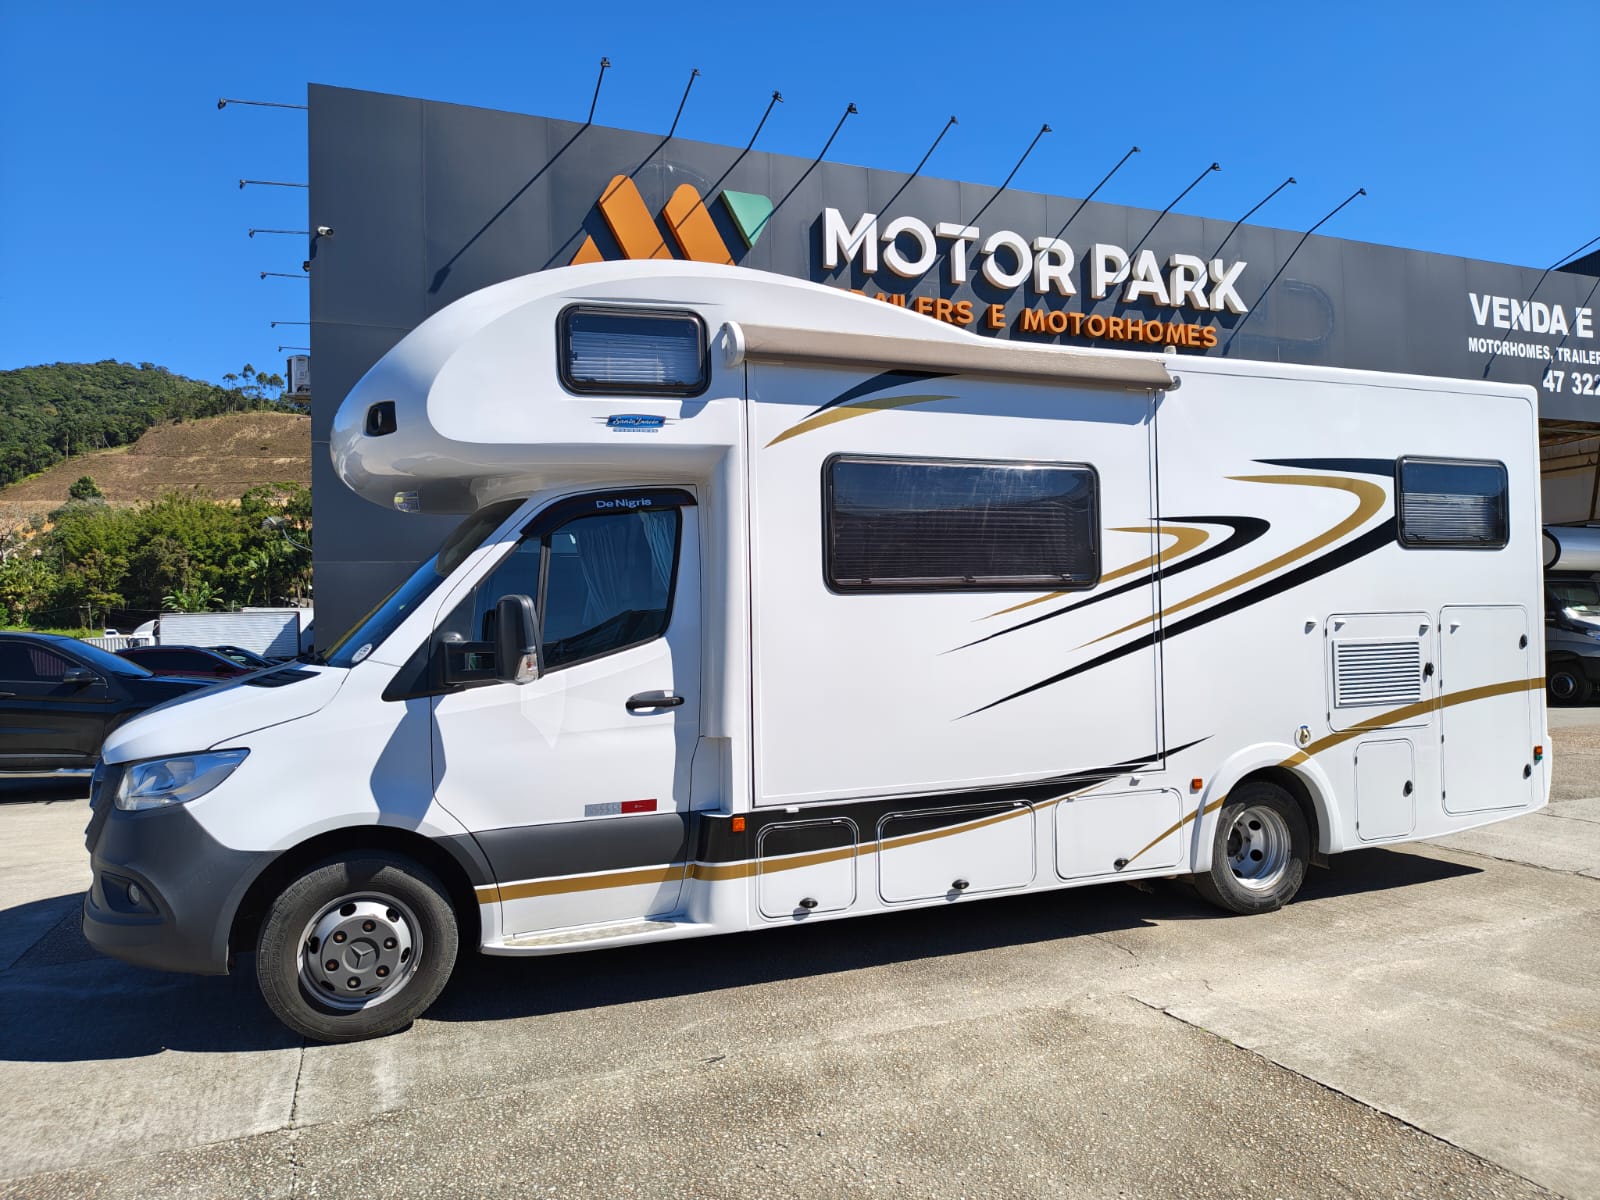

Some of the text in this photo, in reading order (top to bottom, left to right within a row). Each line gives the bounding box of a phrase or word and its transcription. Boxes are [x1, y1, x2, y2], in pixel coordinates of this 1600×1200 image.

[823, 207, 1248, 314] MOTOR PARK
[986, 303, 1007, 329] E
[1021, 308, 1218, 348] MOTORHOMES
[1468, 292, 1594, 339] VENDA E
[1468, 337, 1554, 363] MOTORHOMES,
[1542, 369, 1565, 393] 47
[595, 497, 652, 509] De Nigris
